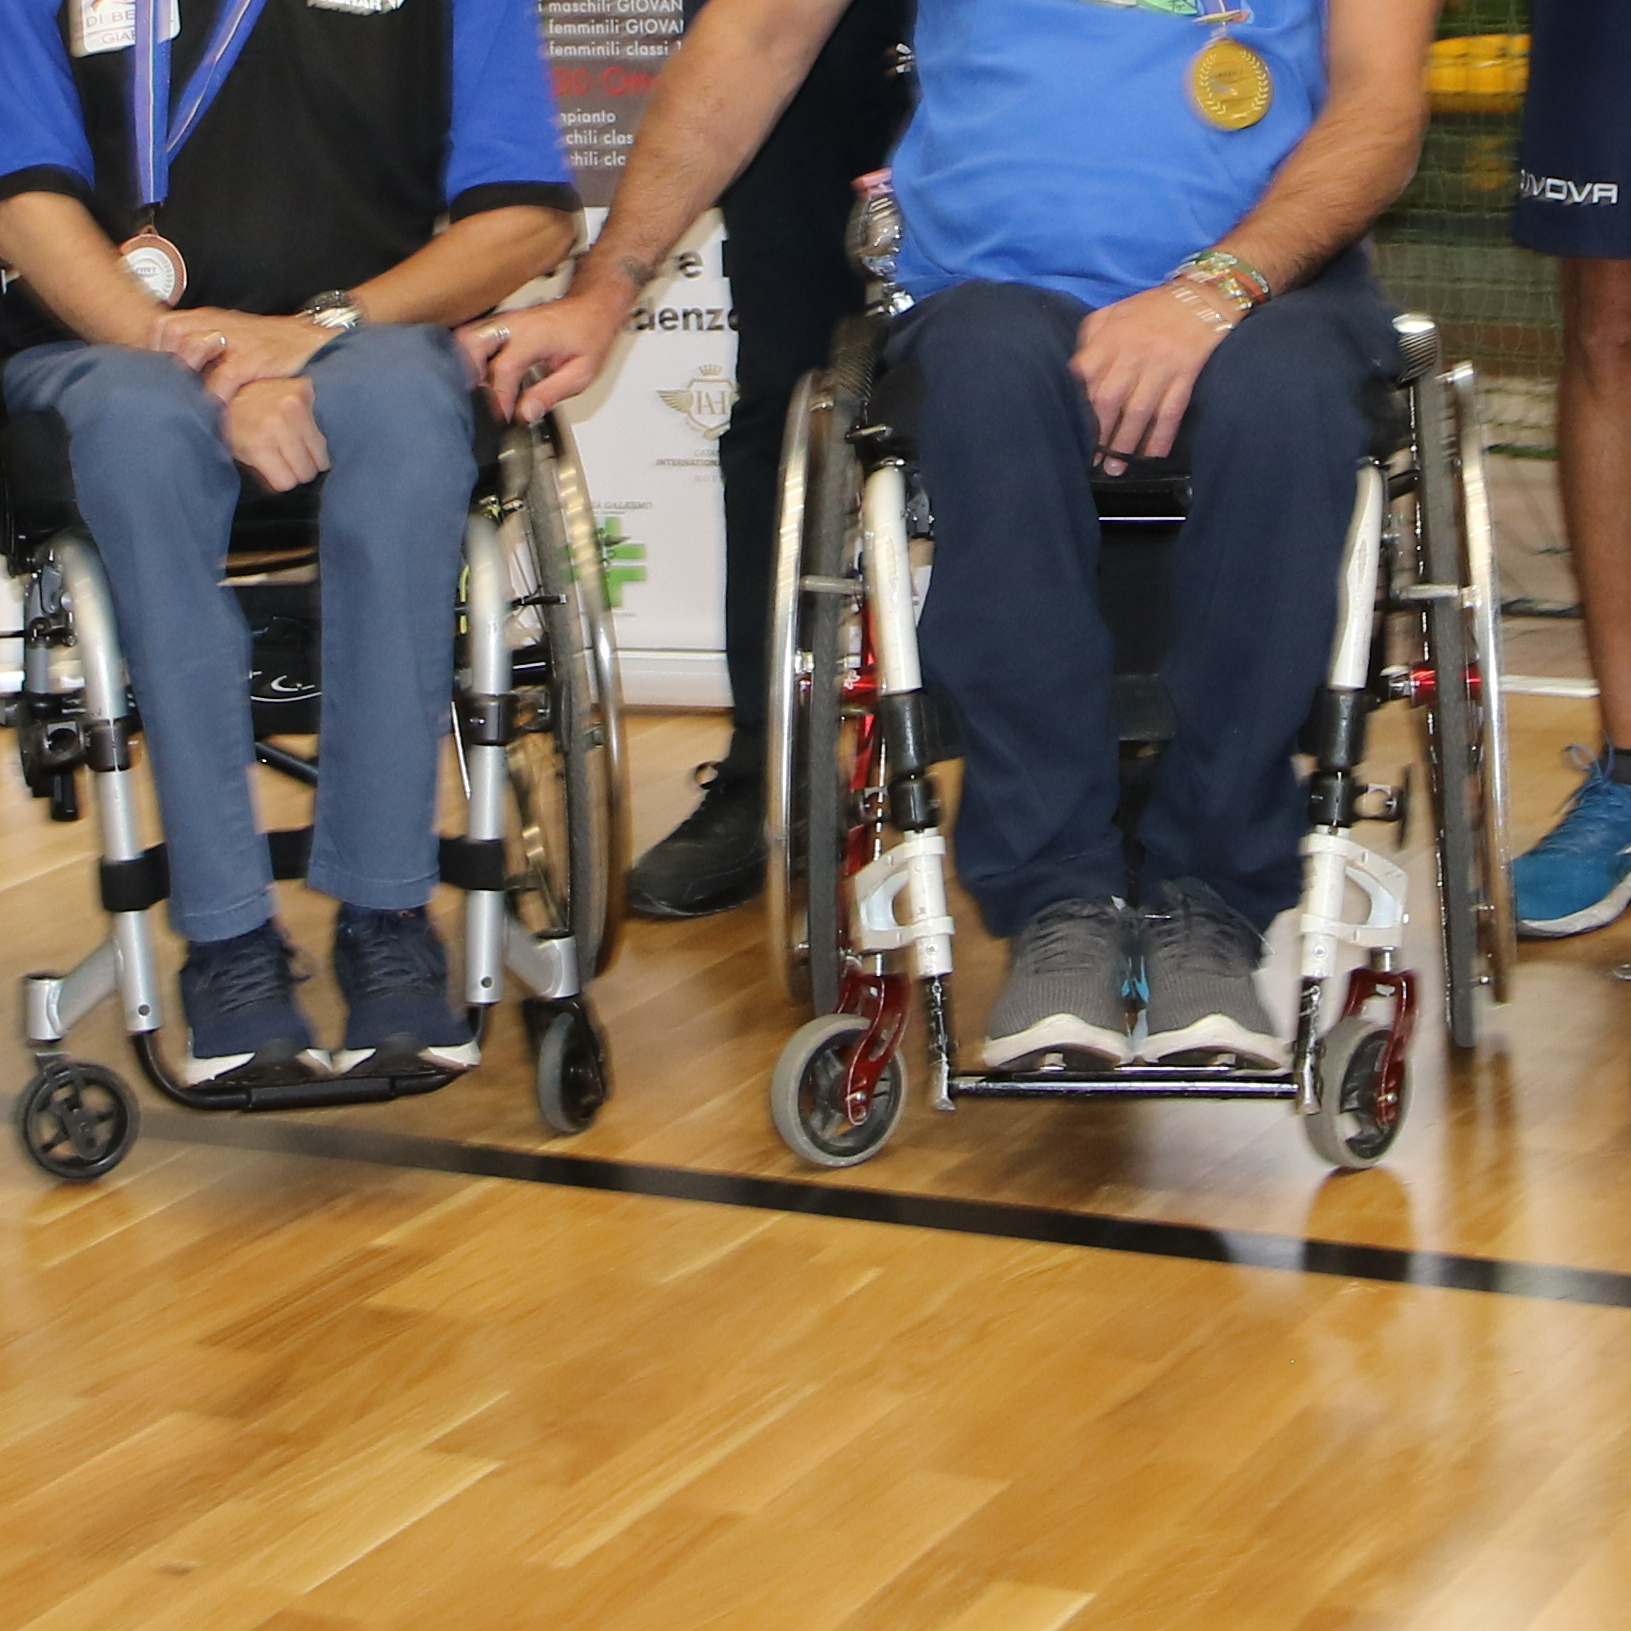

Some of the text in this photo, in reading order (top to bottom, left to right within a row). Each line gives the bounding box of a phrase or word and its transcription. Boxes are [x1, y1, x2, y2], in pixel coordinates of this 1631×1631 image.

[549, 19, 618, 35] femminili
[549, 41, 620, 56] femminili
[627, 40, 669, 56] classi
